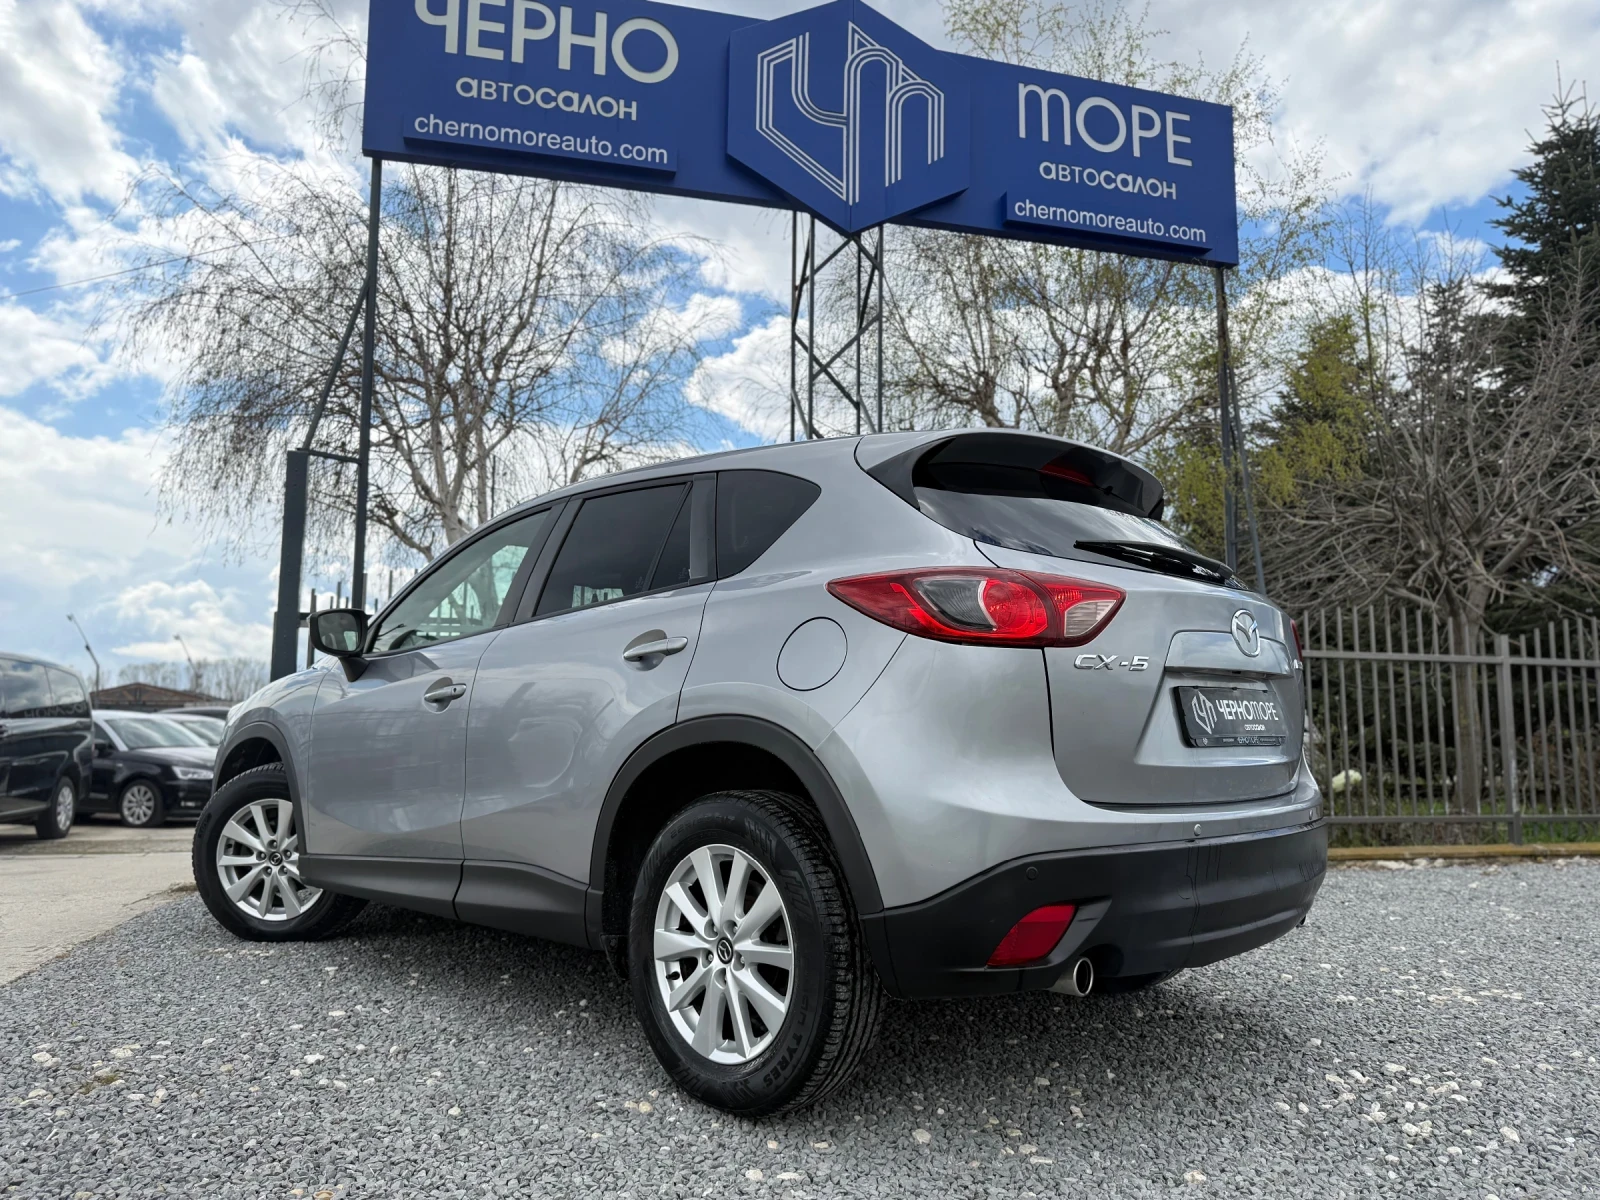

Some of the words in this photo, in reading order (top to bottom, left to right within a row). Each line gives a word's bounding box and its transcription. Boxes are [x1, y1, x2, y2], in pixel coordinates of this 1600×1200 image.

[414, 0, 679, 83] ЧЕРНО
[414, 113, 668, 164] chernomoreauto.com
[1014, 199, 1206, 242] chernomoreauto.com
[1073, 654, 1149, 671] CX-5
[763, 1032, 803, 1087] TYRES
